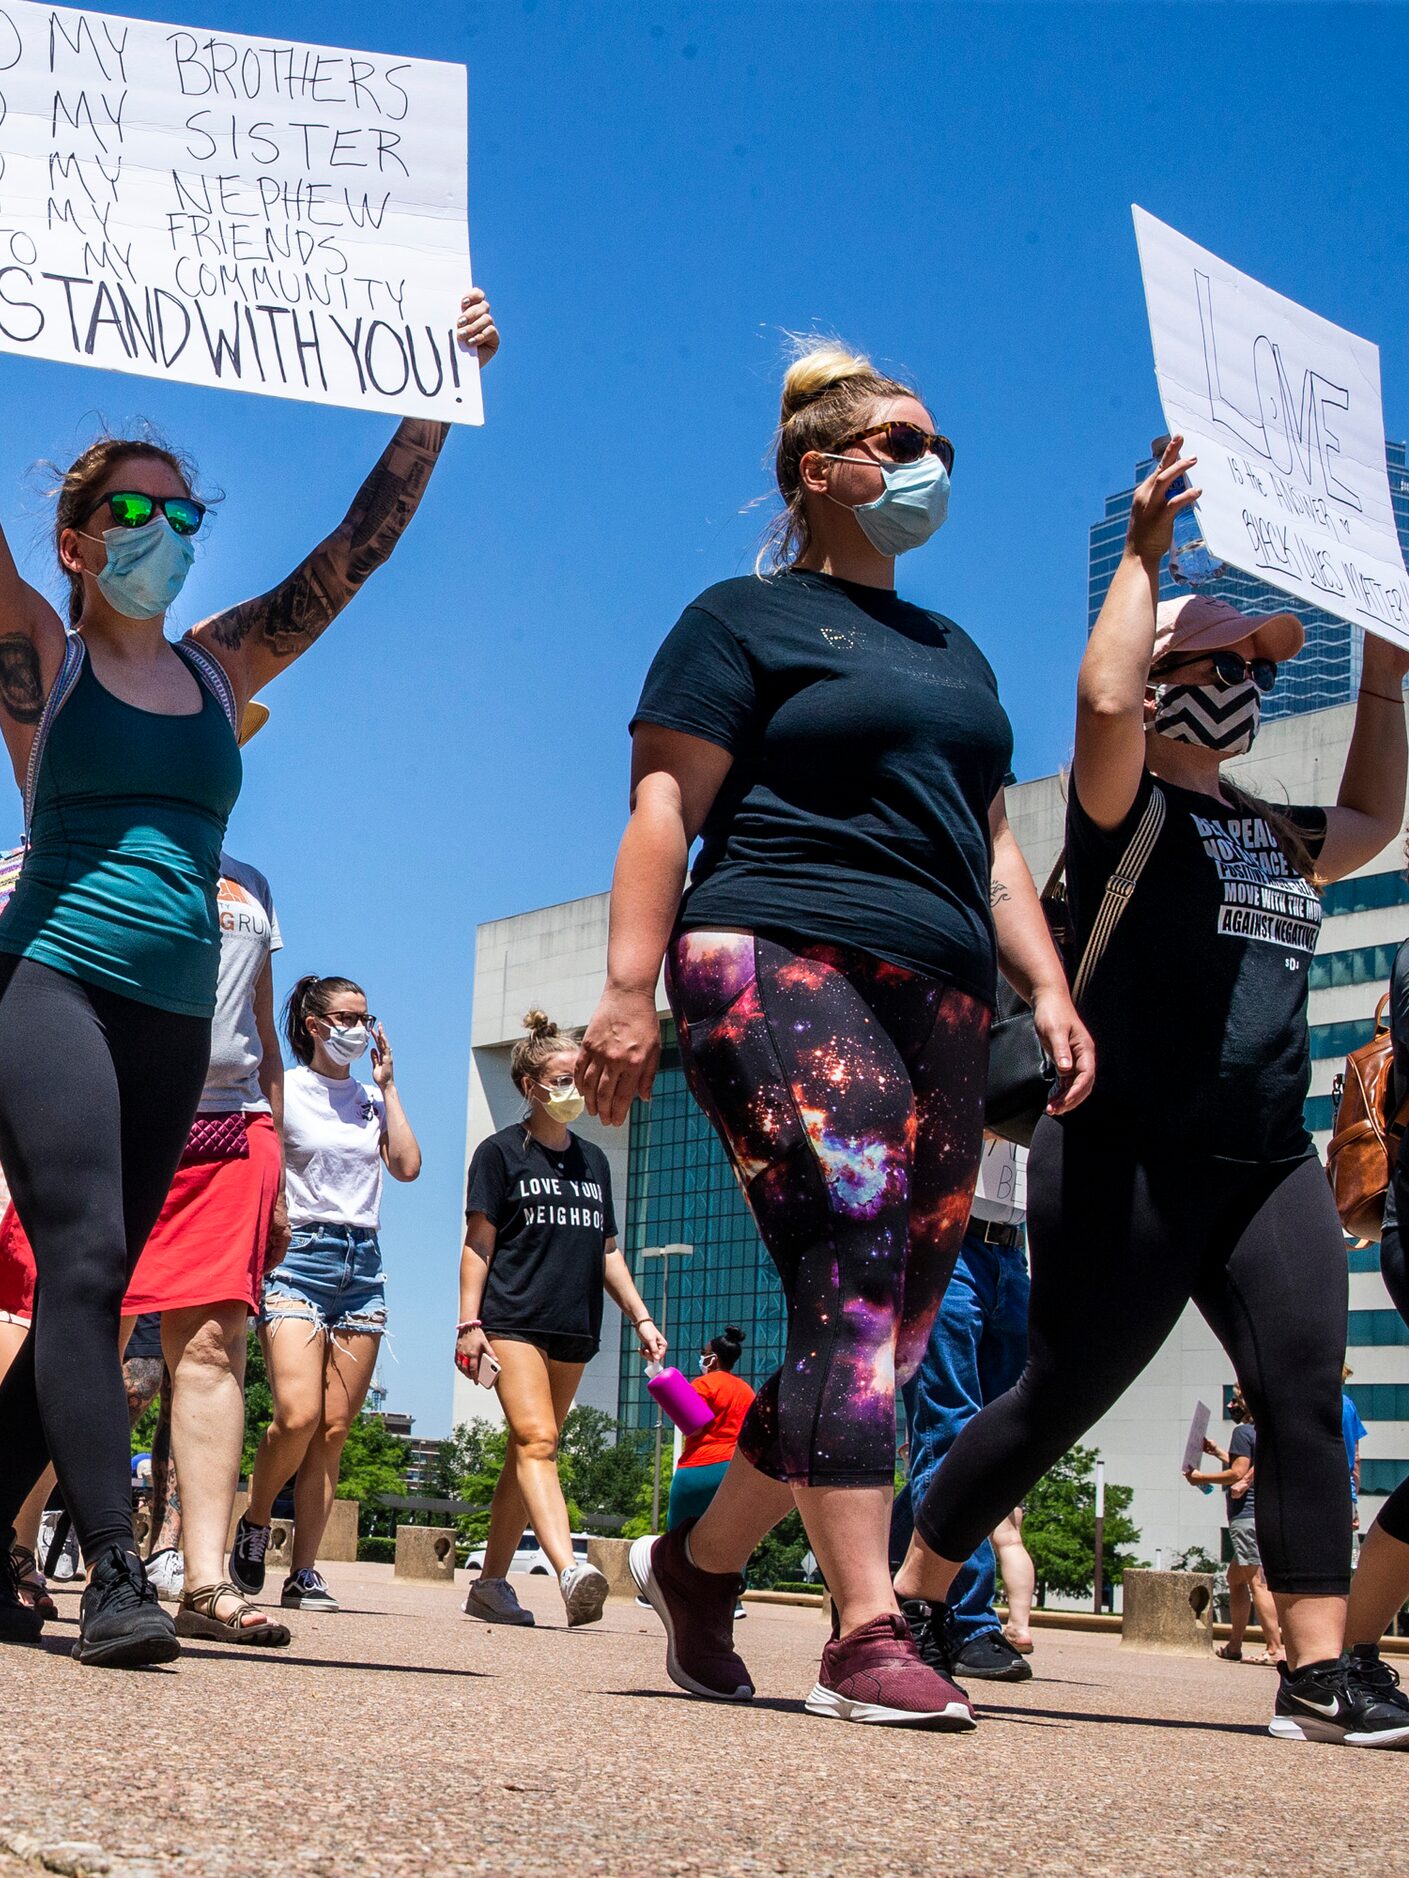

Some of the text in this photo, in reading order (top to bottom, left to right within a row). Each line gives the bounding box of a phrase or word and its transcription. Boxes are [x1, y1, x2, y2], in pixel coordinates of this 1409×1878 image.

[49, 12, 128, 83] MY
[166, 32, 411, 120] BROTHERS
[52, 89, 128, 152] MY
[185, 110, 409, 176] SISTER
[49, 152, 122, 202] MY
[172, 169, 390, 229] NEPHEW
[48, 197, 110, 241] MY
[166, 213, 348, 275] FRIENDS
[84, 242, 137, 284] MY
[175, 256, 405, 319] COMMUNITY
[1194, 268, 1362, 513] LOVE
[1269, 472, 1340, 542] ANSWER
[1222, 909, 1274, 941] AGAINST
[1224, 882, 1260, 907] MOVE
[1261, 887, 1286, 914] WITH
[1287, 895, 1305, 918] THE
[520, 1178, 562, 1198] LOVE
